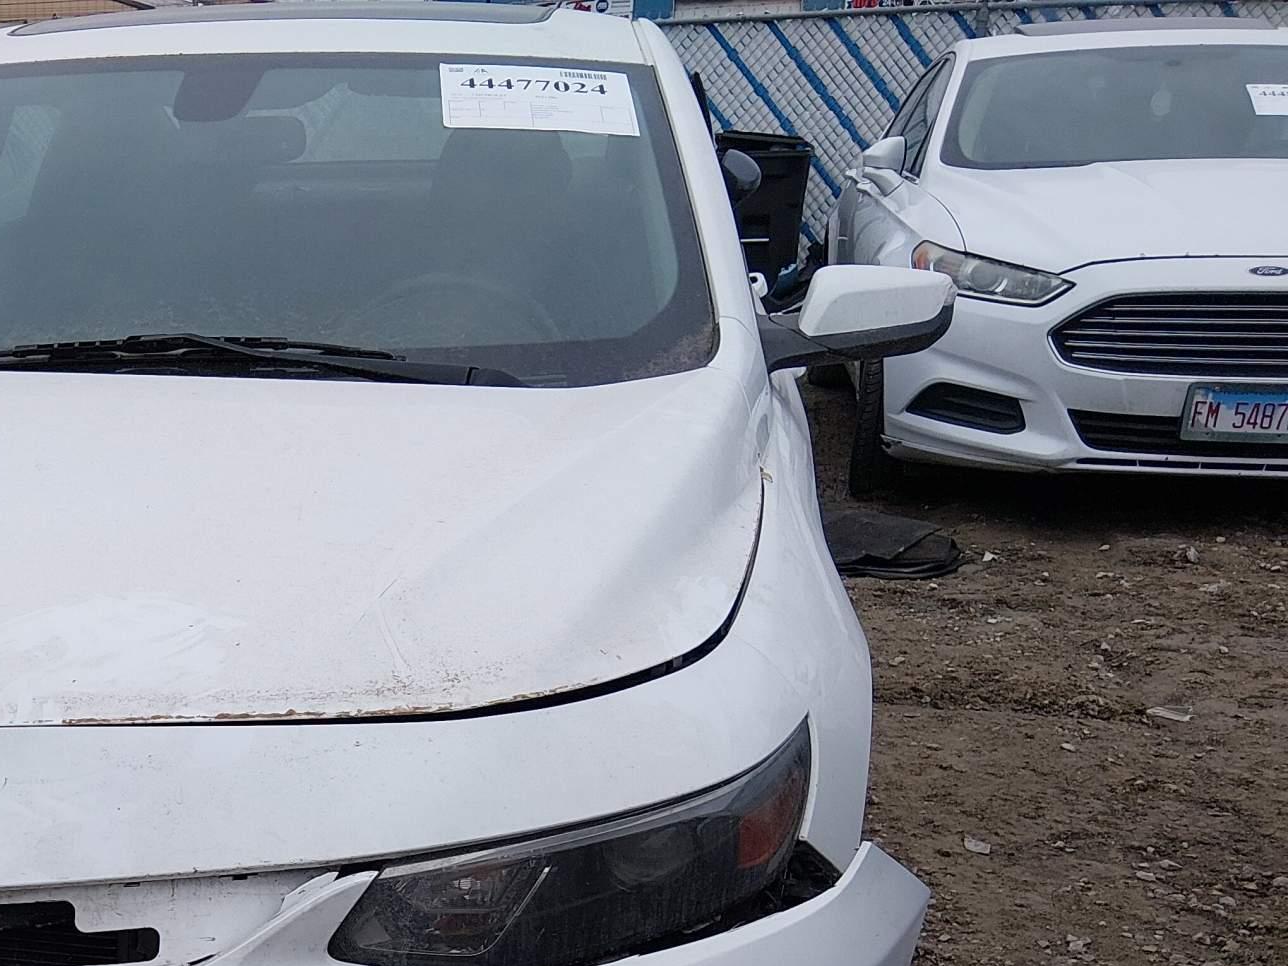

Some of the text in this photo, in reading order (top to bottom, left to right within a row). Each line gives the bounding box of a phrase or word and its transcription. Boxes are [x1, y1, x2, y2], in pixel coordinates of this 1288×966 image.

[460, 77, 608, 95] 44477024
[1191, 400, 1288, 430] FM 5487
